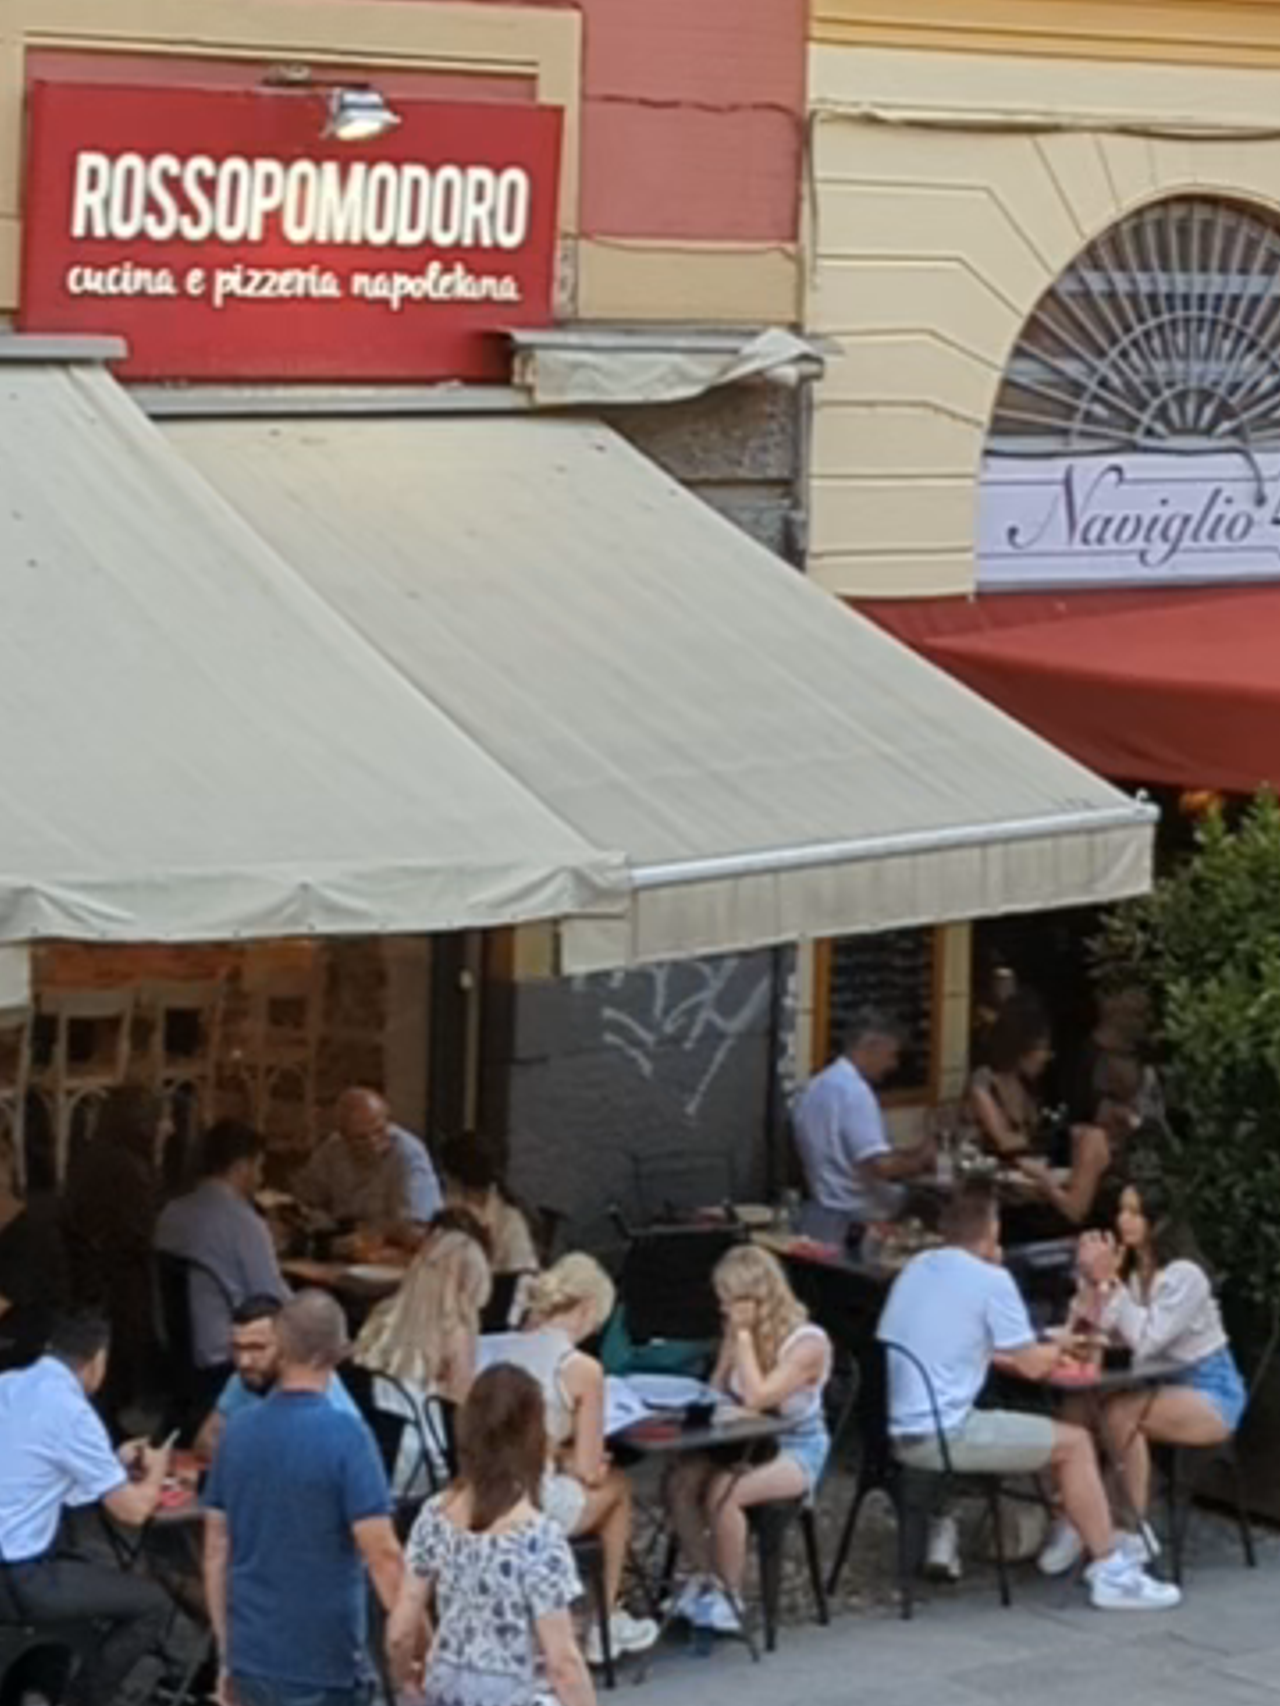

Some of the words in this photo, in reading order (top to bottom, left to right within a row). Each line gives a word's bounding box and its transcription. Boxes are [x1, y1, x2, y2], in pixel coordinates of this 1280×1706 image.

[70, 149, 529, 249] ROSSOPOMODORO
[67, 260, 178, 297] cucina
[185, 268, 206, 297] e
[212, 264, 341, 308] pizzeria
[350, 260, 522, 311] napoletana
[1006, 462, 1256, 568] Naviglio
